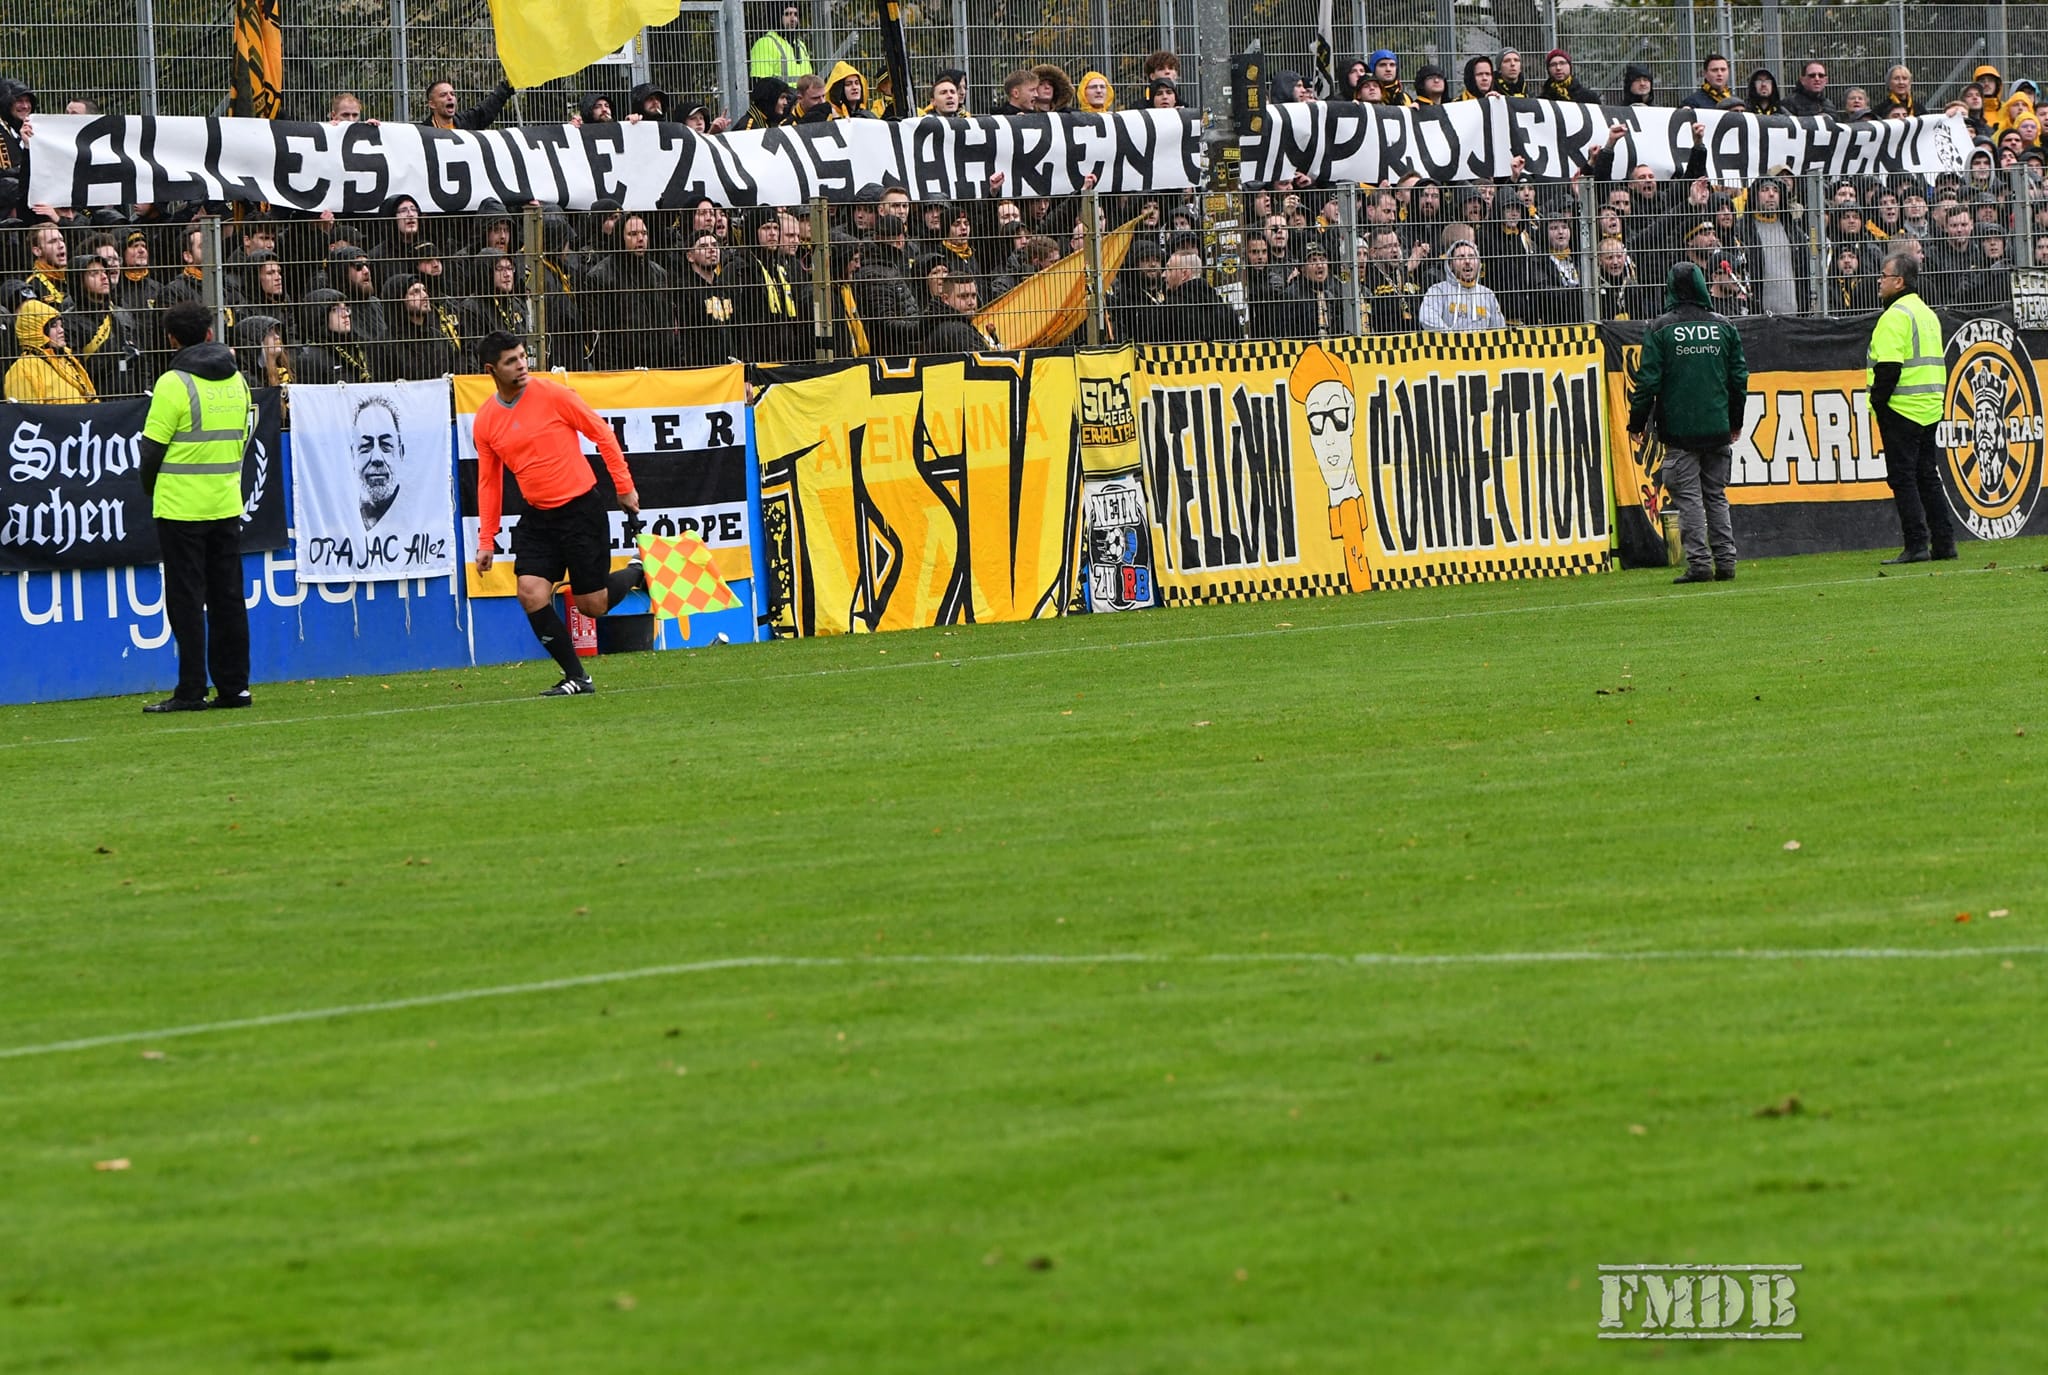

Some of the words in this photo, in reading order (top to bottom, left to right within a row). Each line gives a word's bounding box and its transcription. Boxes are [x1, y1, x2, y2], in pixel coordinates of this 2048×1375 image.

[71, 114, 390, 213] ALLES
[417, 121, 628, 213] GUTE
[656, 121, 758, 209] ZU
[761, 121, 855, 206] 15
[881, 107, 1156, 201] JAHREN
[1674, 325, 1720, 341] SYDE
[1675, 343, 1721, 356] Security
[1955, 321, 2015, 354] KARLS
[814, 397, 1049, 474] ALEMANNA
[1103, 407, 1133, 427] REGE
[1729, 391, 1889, 485] KARL
[1140, 380, 1297, 571] YELLOW
[1369, 364, 1606, 554] CONNECTION
[0, 486, 127, 555] achen
[1091, 490, 1139, 527] NEIN
[1966, 504, 2026, 540] BANDE
[309, 536, 353, 568] OPA
[357, 534, 399, 570] JAC
[1095, 564, 1117, 600] ZU
[1122, 565, 1150, 602] RB
